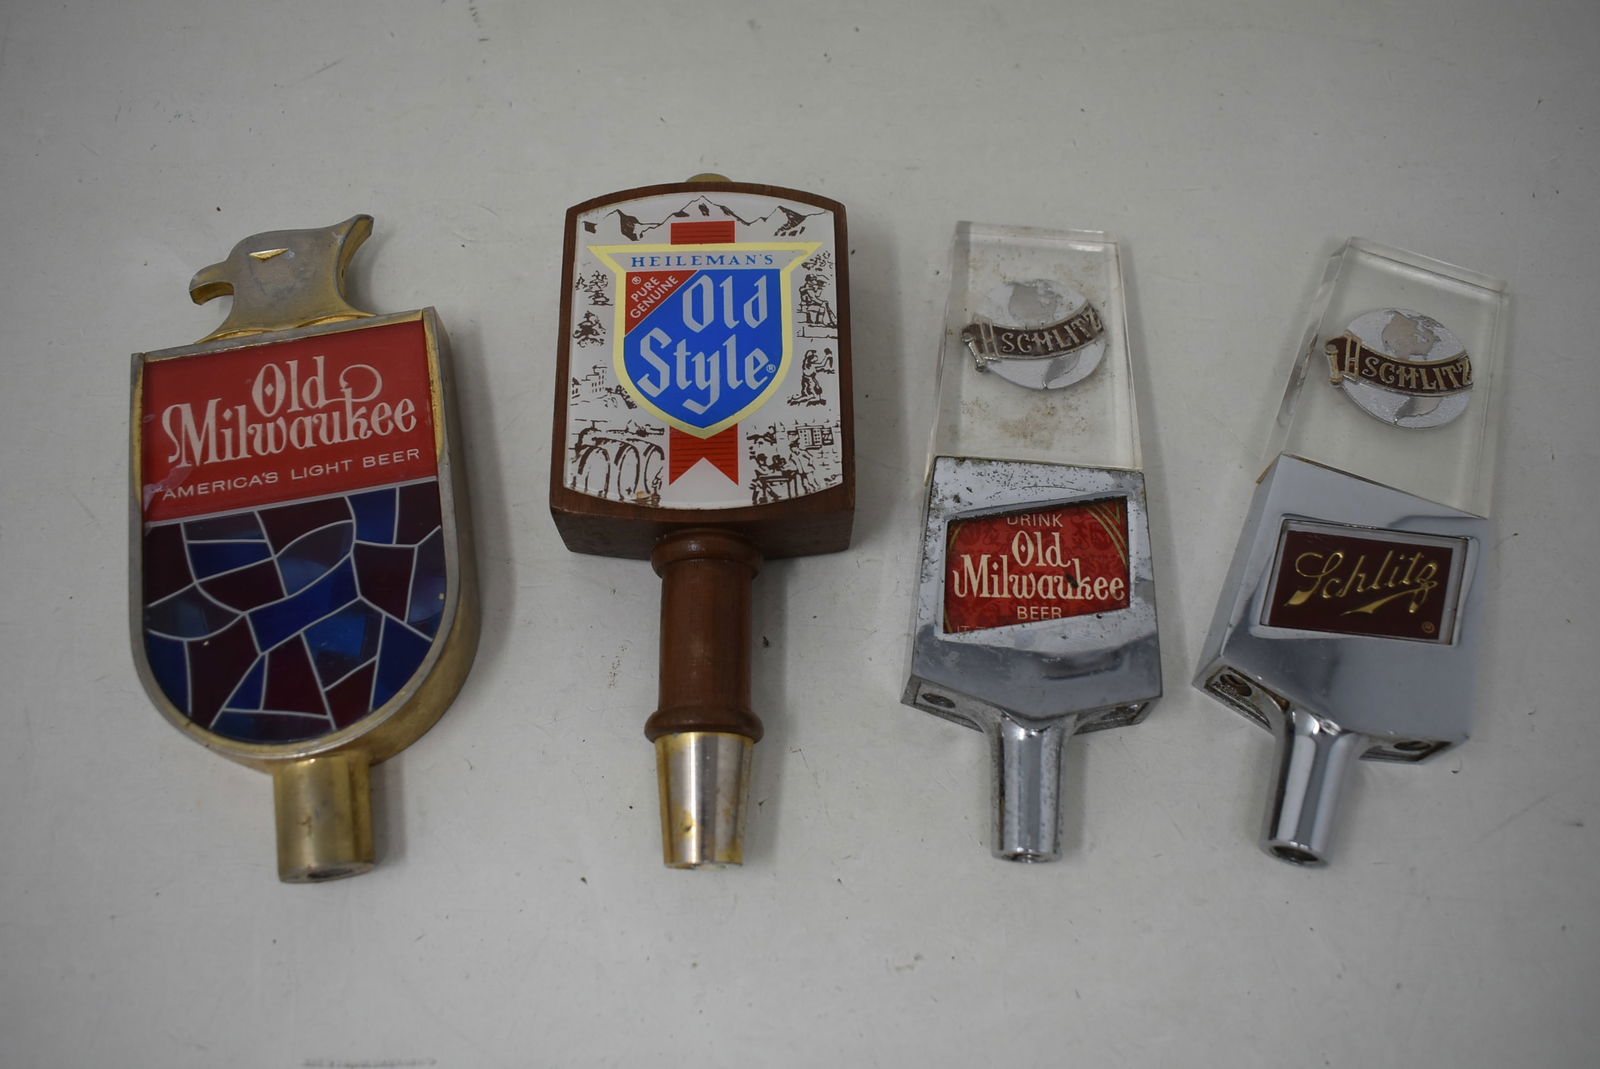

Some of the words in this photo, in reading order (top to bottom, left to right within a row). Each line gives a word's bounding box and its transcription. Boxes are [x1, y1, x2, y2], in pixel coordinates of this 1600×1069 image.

[631, 254, 773, 268] HEILEMAN'S
[630, 275, 679, 319] GENUINE
[631, 276, 660, 303] PURE
[682, 274, 768, 333] Old
[1001, 306, 1102, 353] SCHLITZ
[252, 356, 338, 418] Old
[638, 326, 769, 415] Style
[1361, 356, 1472, 391] SCHLITZ
[162, 386, 417, 468] Milwaukee
[162, 471, 279, 501] AMERICA'S
[290, 459, 353, 480] LIGHT
[362, 448, 421, 468] BEER
[1007, 513, 1063, 527] DRINK
[1011, 530, 1071, 567] Old
[952, 554, 1126, 600] Milwaukee
[1284, 550, 1438, 616] Schlitz
[1017, 606, 1062, 620] BEER
